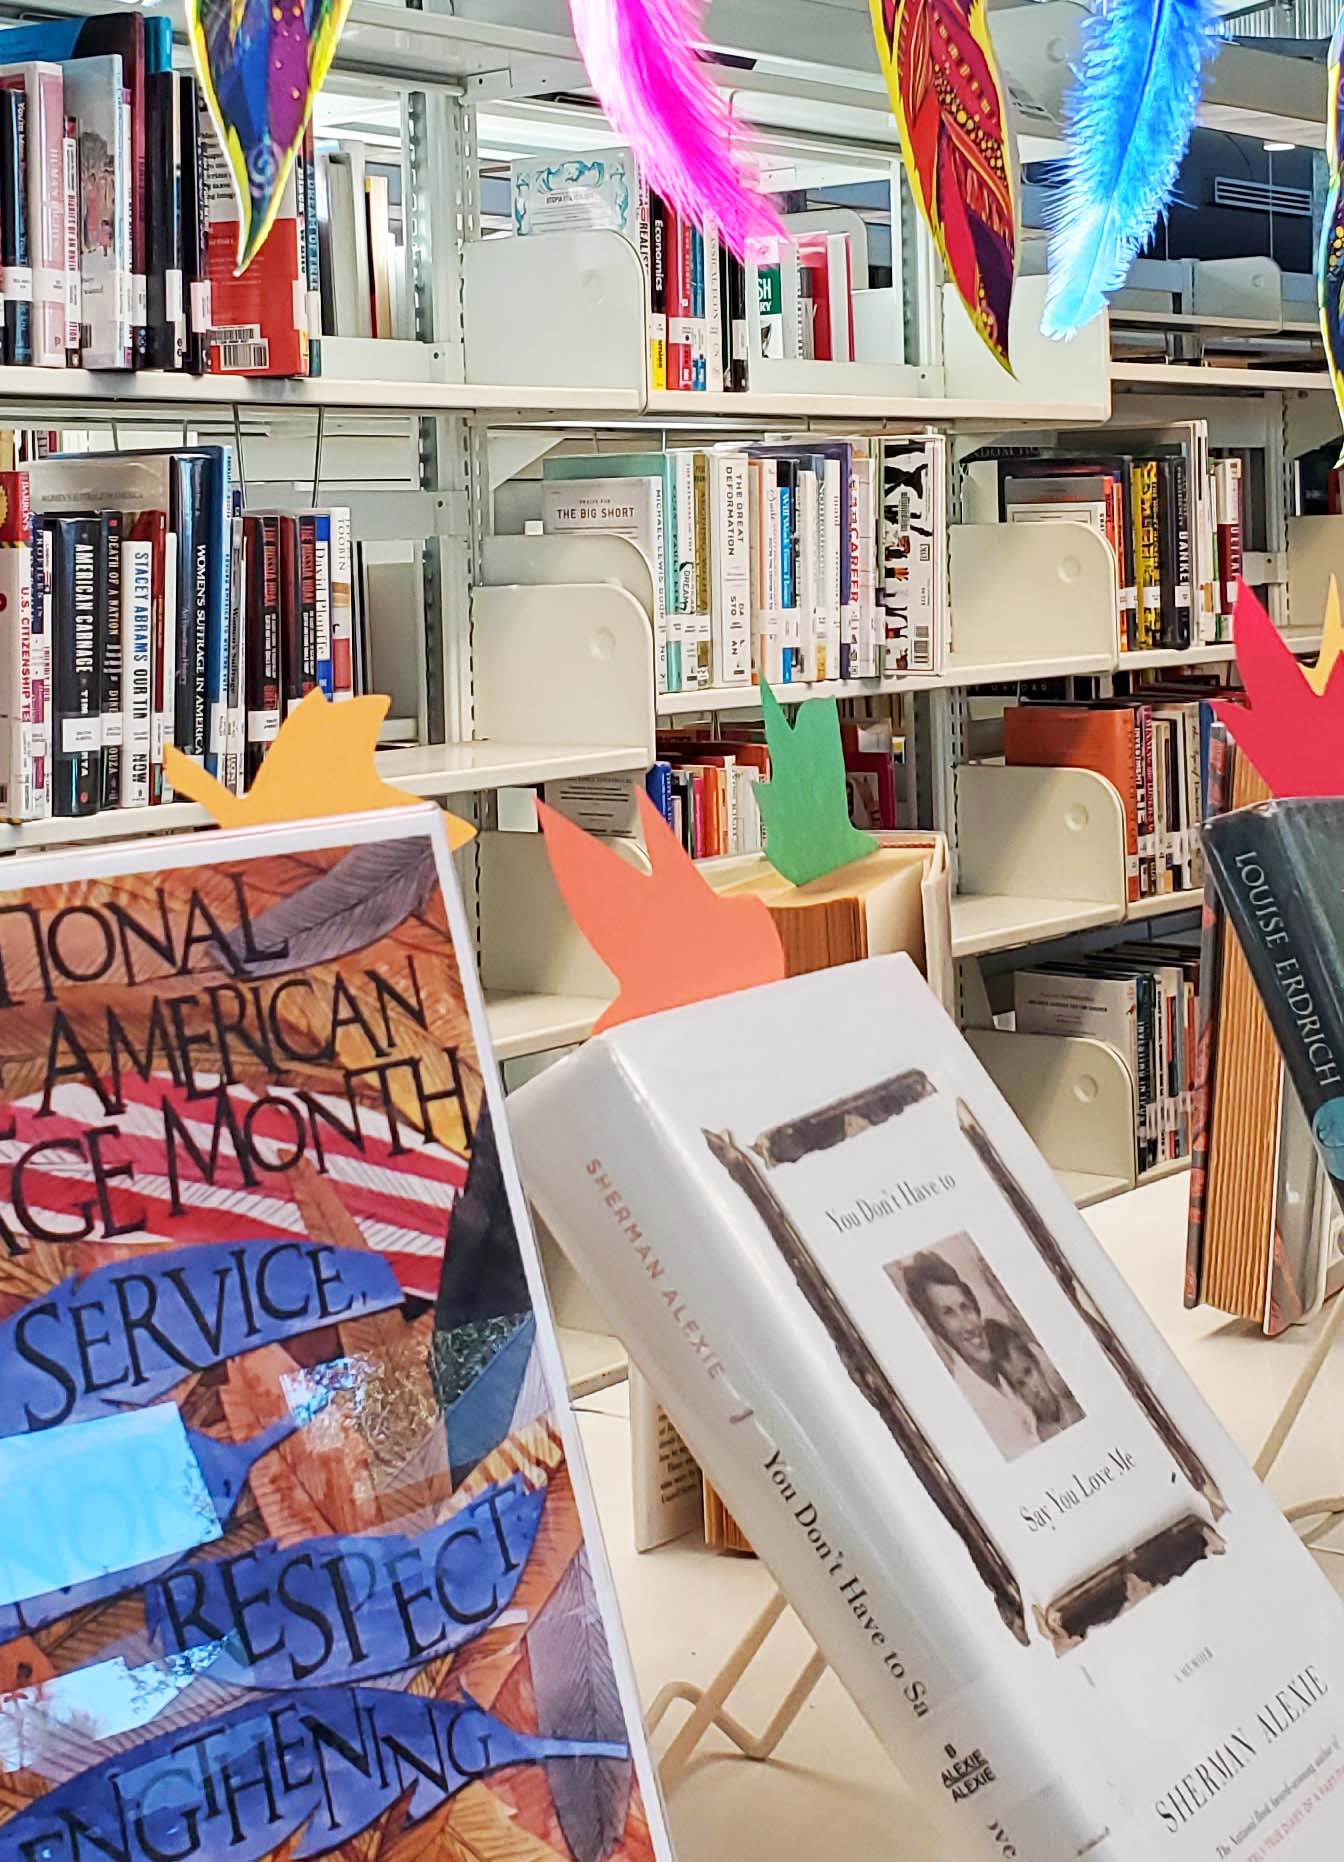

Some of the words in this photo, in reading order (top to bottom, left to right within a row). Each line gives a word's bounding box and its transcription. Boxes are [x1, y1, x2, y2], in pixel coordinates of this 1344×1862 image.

[654, 219, 665, 292] Economics
[557, 508, 577, 520] THE
[580, 507, 598, 519] BIG
[601, 506, 636, 519] SHORT
[725, 465, 736, 557] DEFORMATION
[734, 474, 744, 498] THE
[107, 535, 119, 569] DEATH
[337, 518, 347, 572] TOOBIN
[735, 502, 744, 543] GREAT
[74, 544, 94, 611] AMERICAN
[107, 571, 118, 587] OF
[195, 543, 207, 606] WOMEN'S
[316, 548, 328, 594] David
[849, 526, 859, 603] CAREER
[74, 613, 93, 674] CARNAGE
[108, 599, 119, 637] NATION
[195, 608, 207, 674] SUFFRAGE
[316, 599, 328, 656] Plouffe
[80, 689, 90, 715] TIM
[195, 676, 205, 692] IN
[194, 694, 205, 755] AMERICA
[131, 753, 147, 784] NOW
[1233, 848, 1289, 948] LOUISE
[1276, 958, 1344, 1086] ERDRICH
[41, 953, 434, 1118] AMERICAN
[162, 1044, 474, 1189] MONTH
[824, 1207, 862, 1233] You
[855, 1188, 903, 1223] Don't
[896, 1180, 940, 1207] Have
[938, 1174, 957, 1191] to
[585, 1157, 665, 1281] SHERMAN
[660, 1288, 726, 1381] ALEXIE
[1018, 1504, 1057, 1532] Say
[1044, 1488, 1081, 1514] You
[1072, 1465, 1116, 1498] Love
[1107, 1447, 1137, 1476] Me
[762, 1447, 798, 1504] You
[793, 1502, 845, 1577] Don't
[838, 1574, 887, 1647] Have
[882, 1650, 907, 1680] to
[940, 1748, 990, 1788] ALEXIE
[943, 1743, 958, 1760] B
[1154, 1727, 1258, 1834] SHERMAN
[1256, 1664, 1329, 1744] ALEXIE
[951, 1765, 998, 1804] ALEXIE
